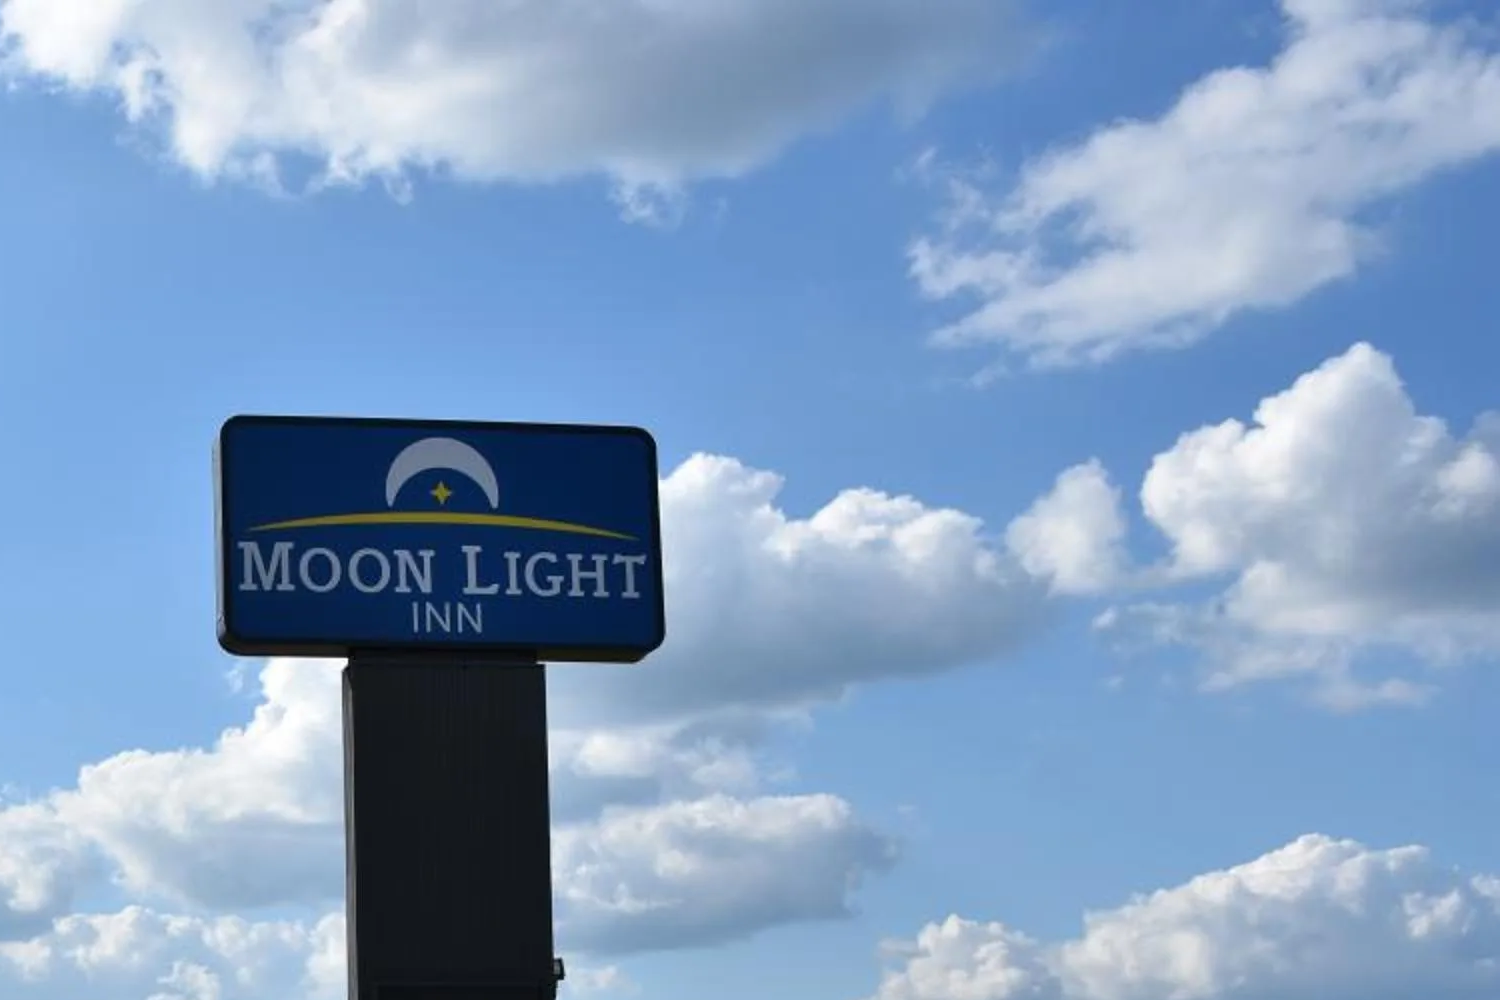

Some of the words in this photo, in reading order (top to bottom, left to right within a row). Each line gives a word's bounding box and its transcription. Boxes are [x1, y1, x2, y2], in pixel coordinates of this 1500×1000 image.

[238, 541, 435, 594] MOON
[461, 545, 647, 598] LIGHT
[411, 602, 483, 633] INN
